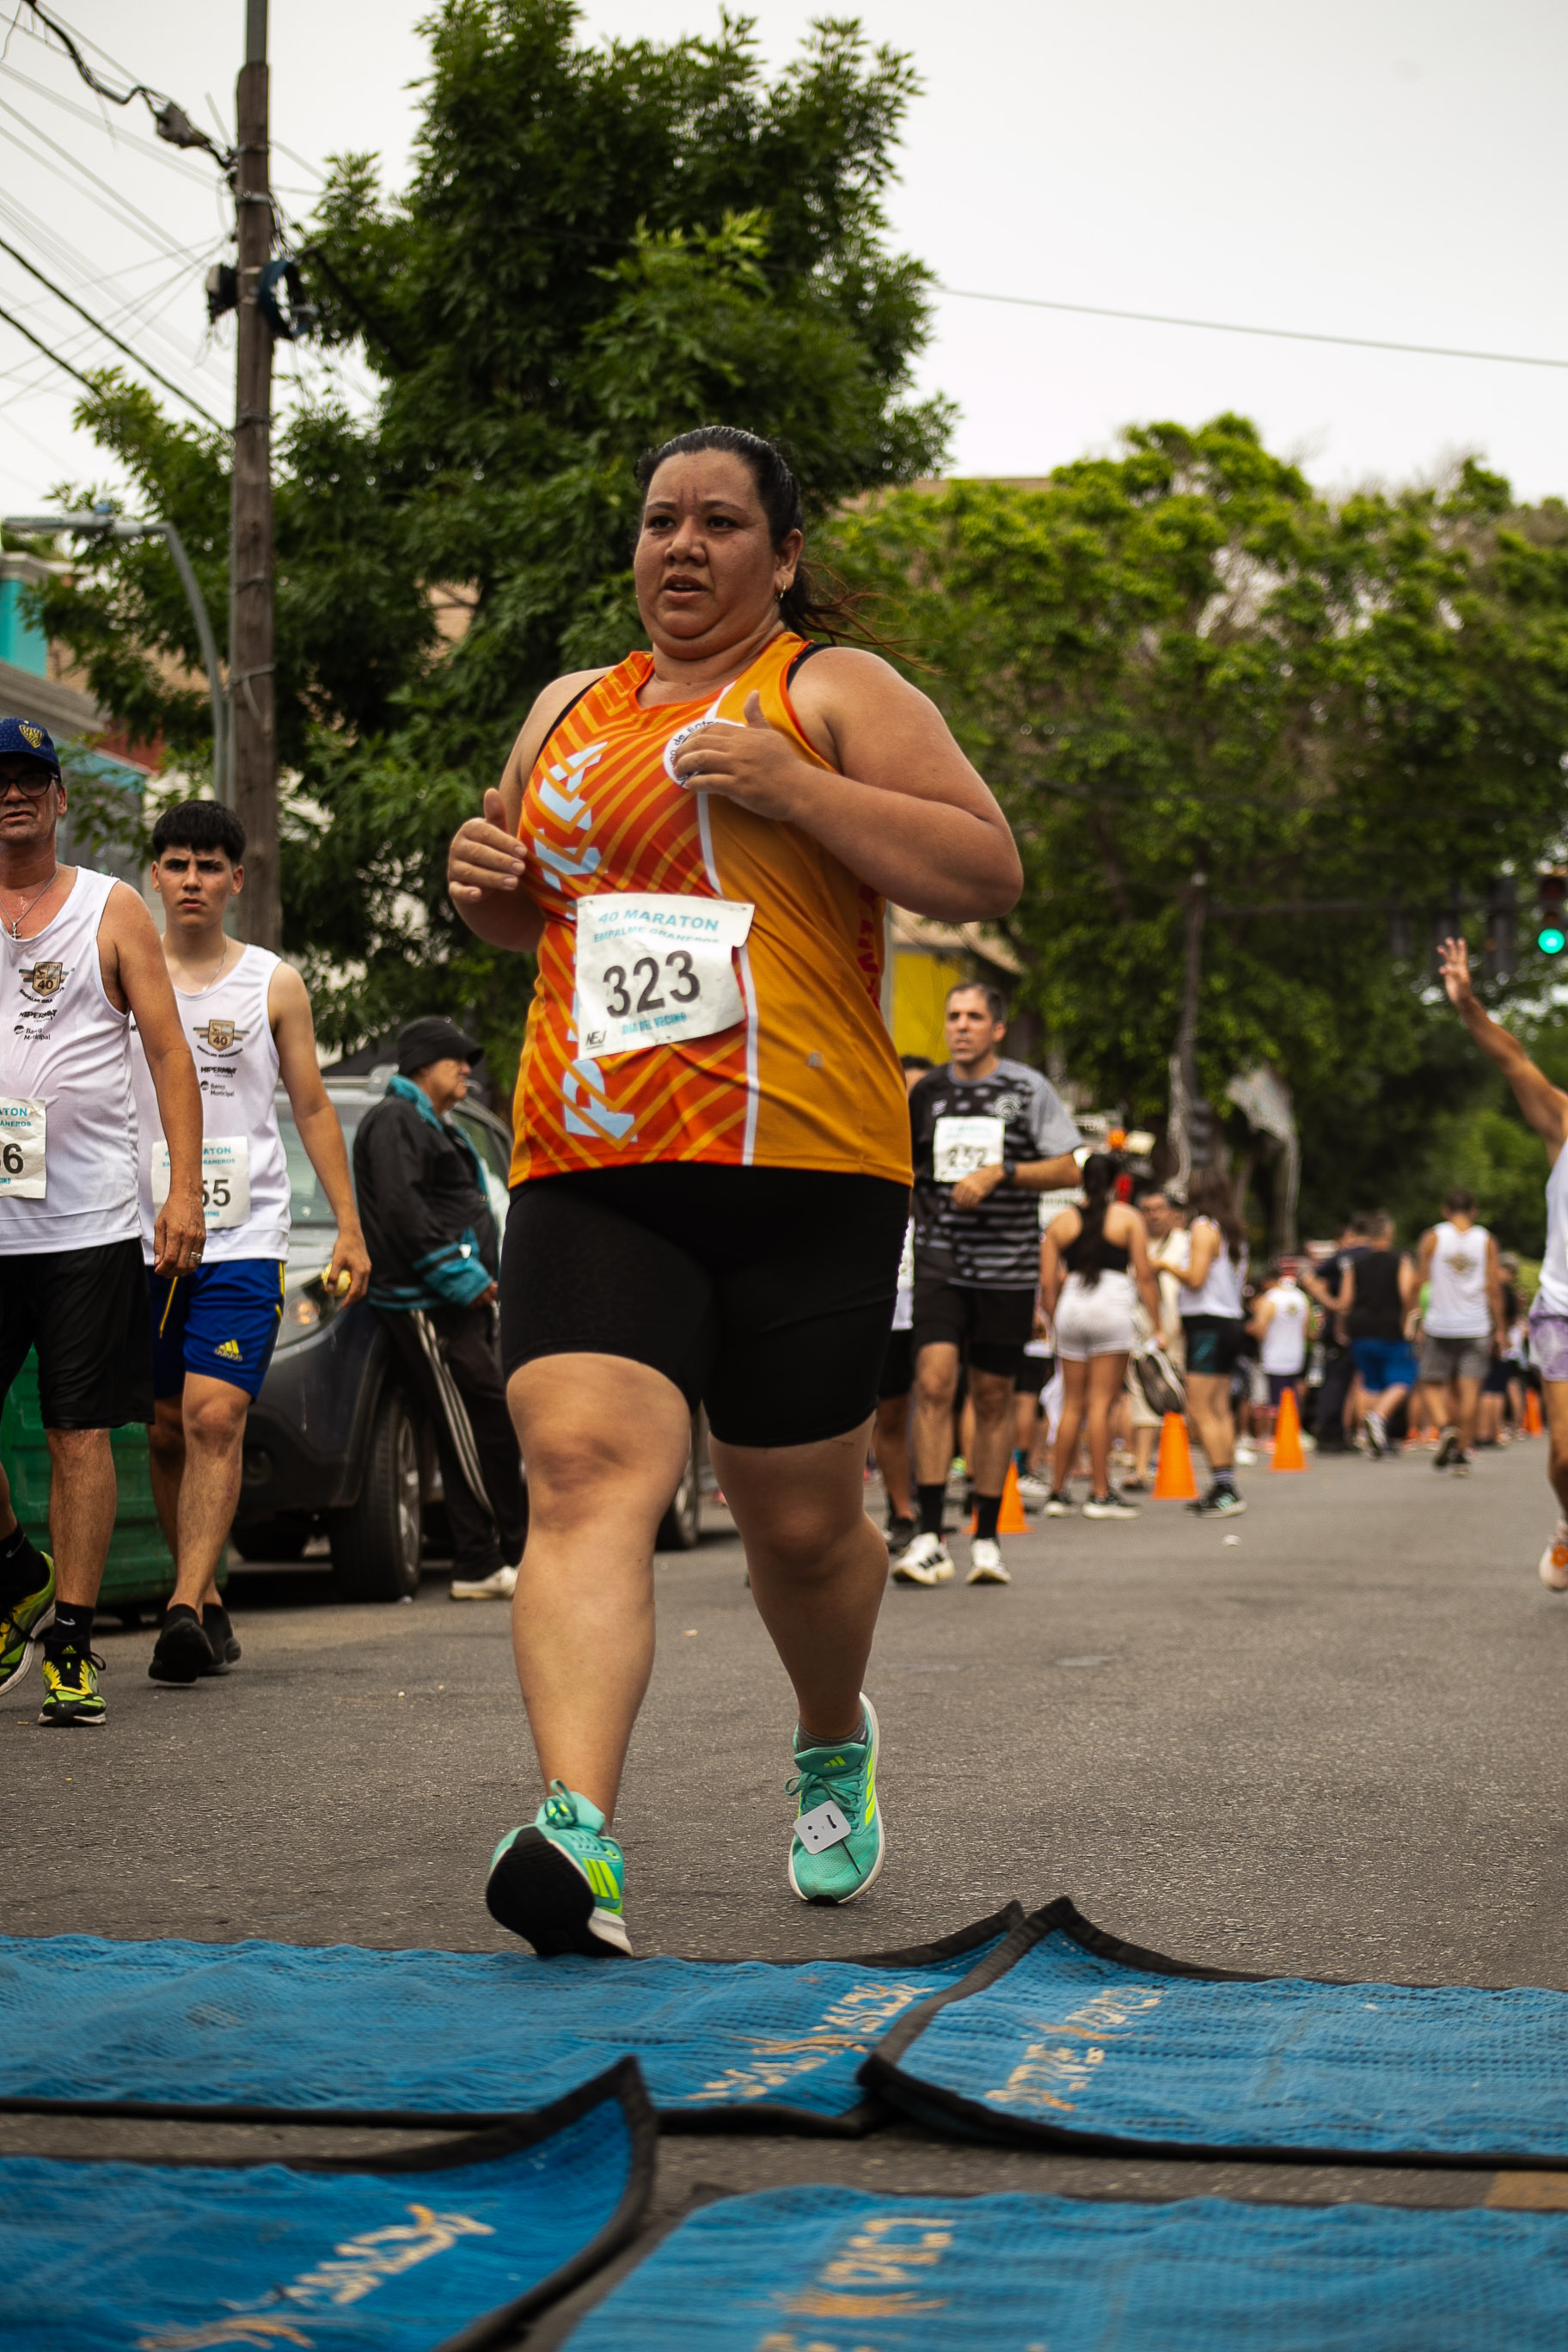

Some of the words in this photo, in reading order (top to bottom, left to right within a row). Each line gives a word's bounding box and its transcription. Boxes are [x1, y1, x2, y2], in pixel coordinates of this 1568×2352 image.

[598, 911, 619, 923] 40
[623, 910, 719, 931] MARATON
[593, 926, 645, 942] EMPALME
[37, 980, 53, 989] 40
[603, 950, 701, 1019] 323
[622, 1022, 638, 1034] DIA
[653, 1012, 687, 1028] VECINO
[213, 1036, 228, 1046] 40
[0, 1142, 24, 1174] 6
